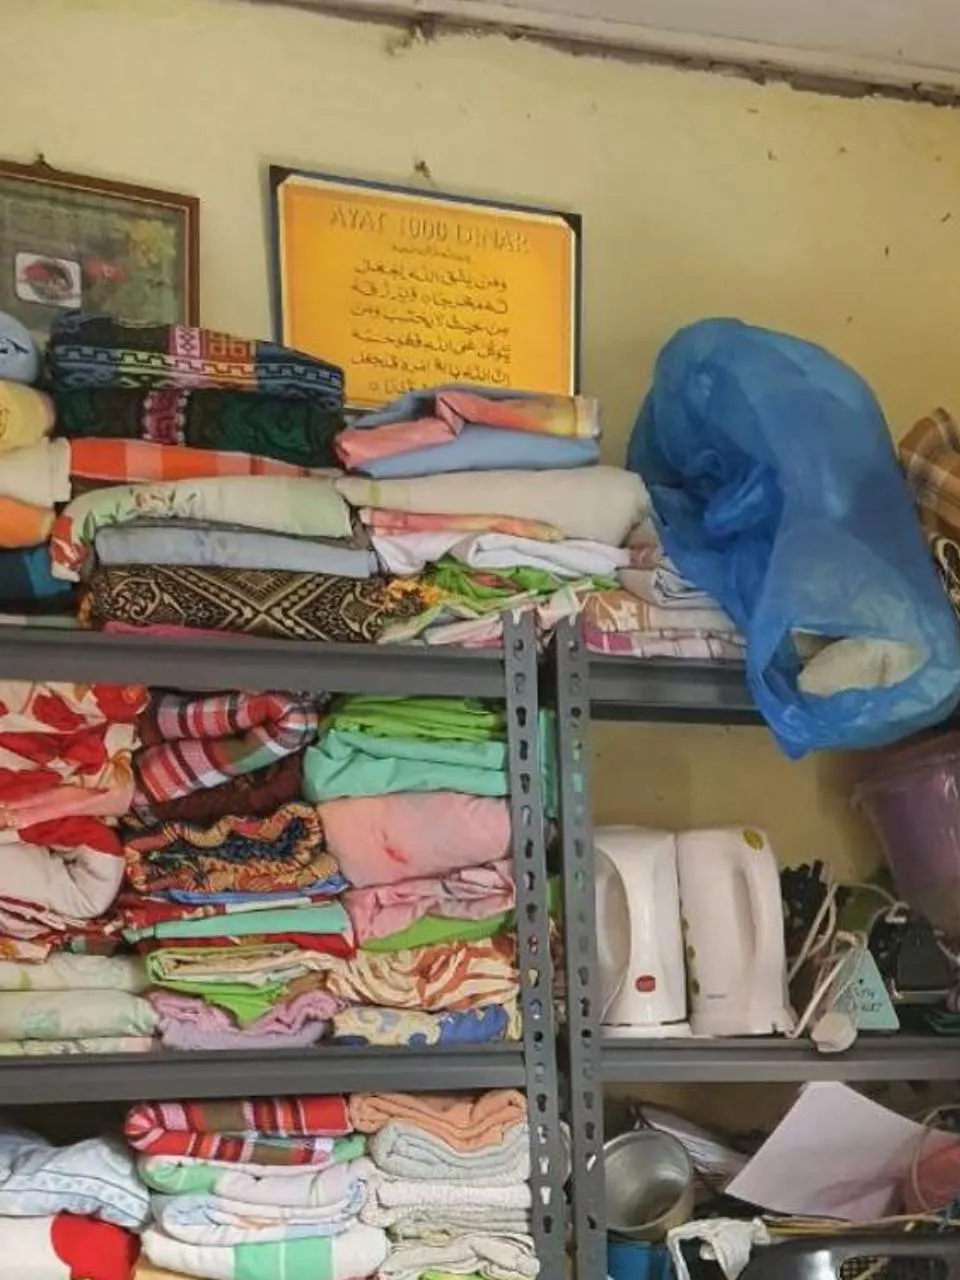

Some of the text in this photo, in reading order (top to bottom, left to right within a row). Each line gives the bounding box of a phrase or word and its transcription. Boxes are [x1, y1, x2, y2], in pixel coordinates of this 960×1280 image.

[330, 202, 387, 233] AYAT
[400, 214, 449, 243] 1000
[456, 222, 531, 254] DINAR
